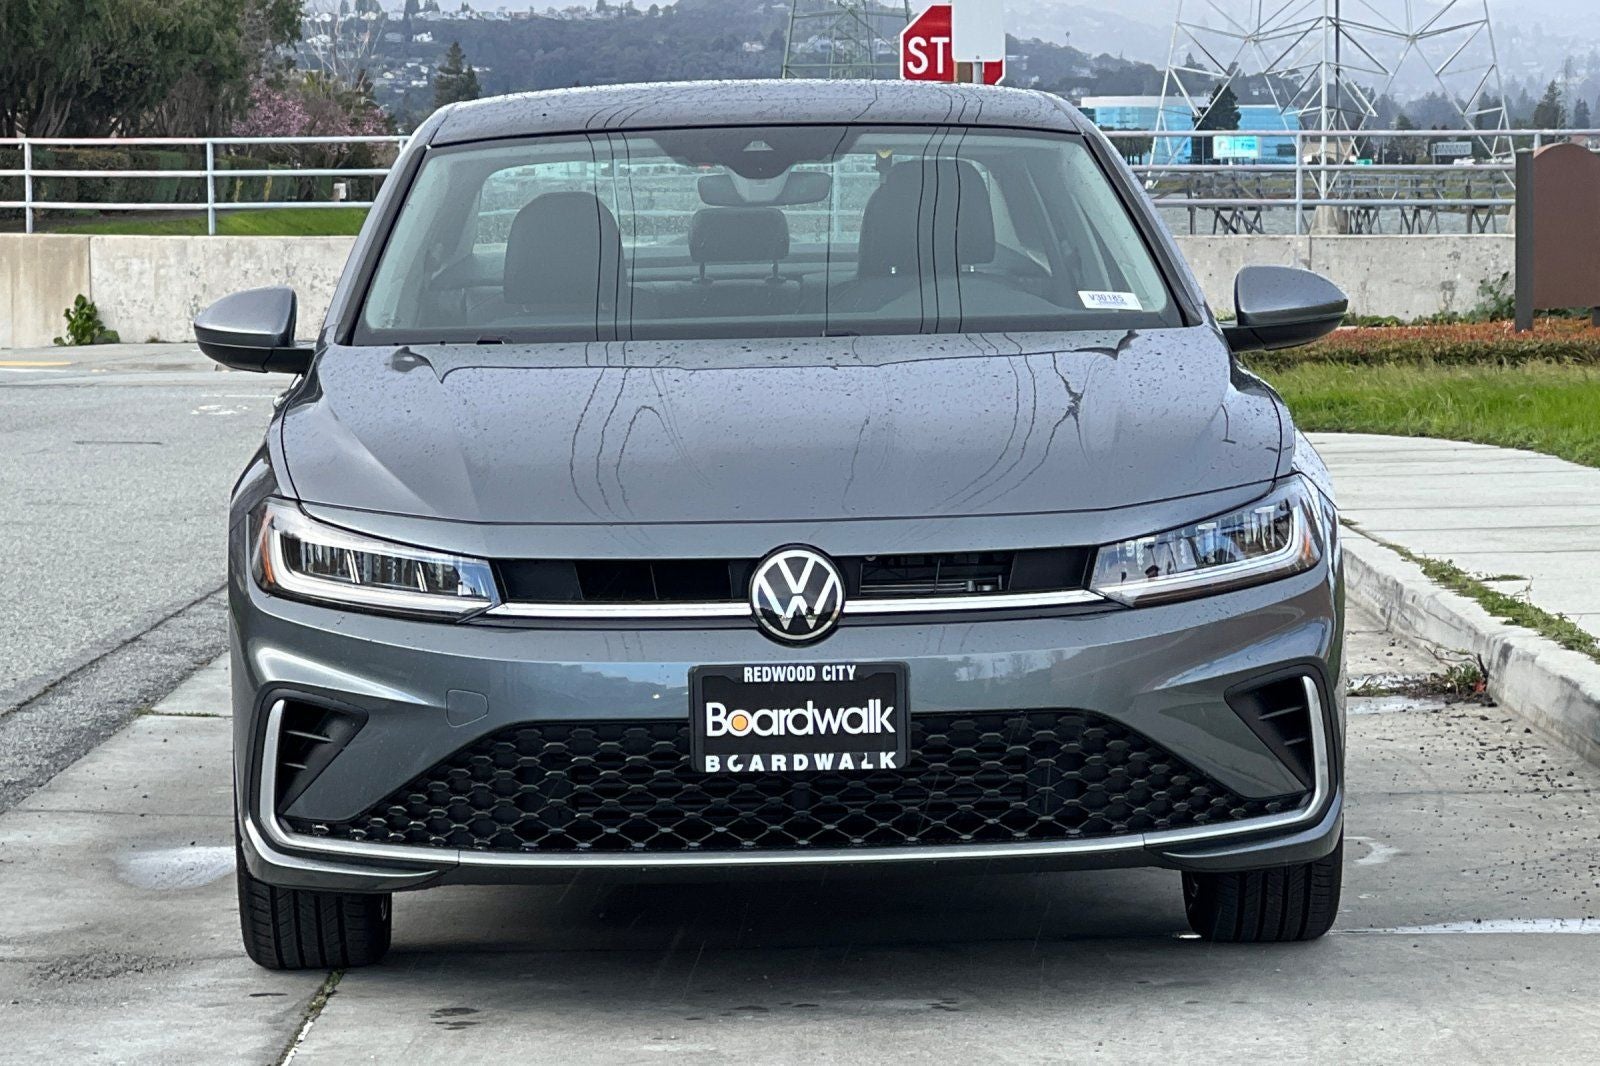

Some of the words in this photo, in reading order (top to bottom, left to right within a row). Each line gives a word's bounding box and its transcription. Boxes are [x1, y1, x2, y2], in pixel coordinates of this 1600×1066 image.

[907, 36, 950, 74] ST
[743, 665, 816, 683] REDWOOD
[822, 664, 857, 681] CITY
[705, 698, 896, 737] Boardwalk
[705, 751, 897, 773] BOARDWALK
